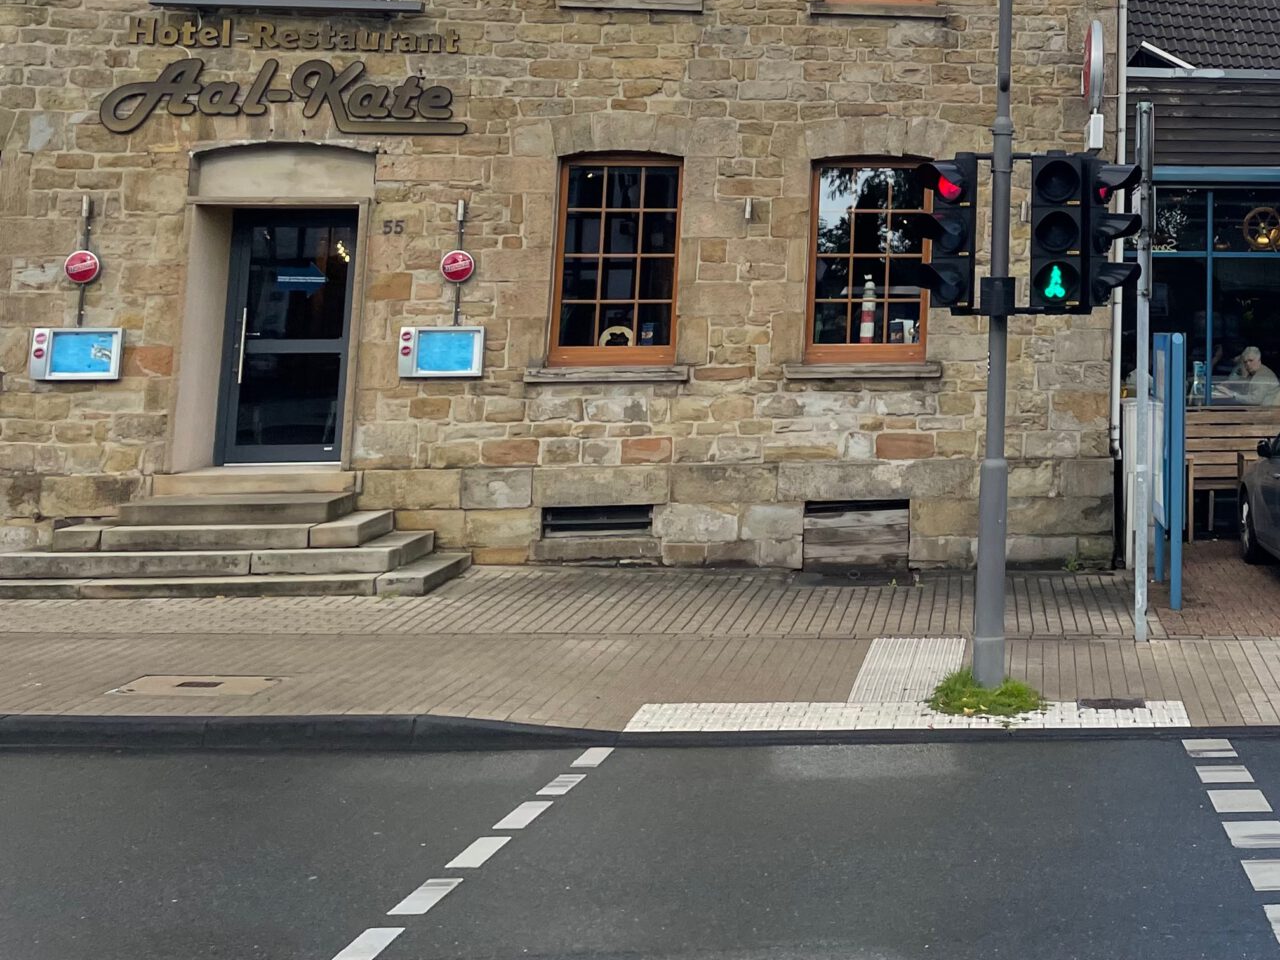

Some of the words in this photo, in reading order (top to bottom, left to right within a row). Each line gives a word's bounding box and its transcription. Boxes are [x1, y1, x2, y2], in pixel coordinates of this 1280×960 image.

[128, 17, 460, 54] Hotel-Restaurant
[100, 57, 468, 135] Aal-Kate
[383, 220, 406, 235] 55
